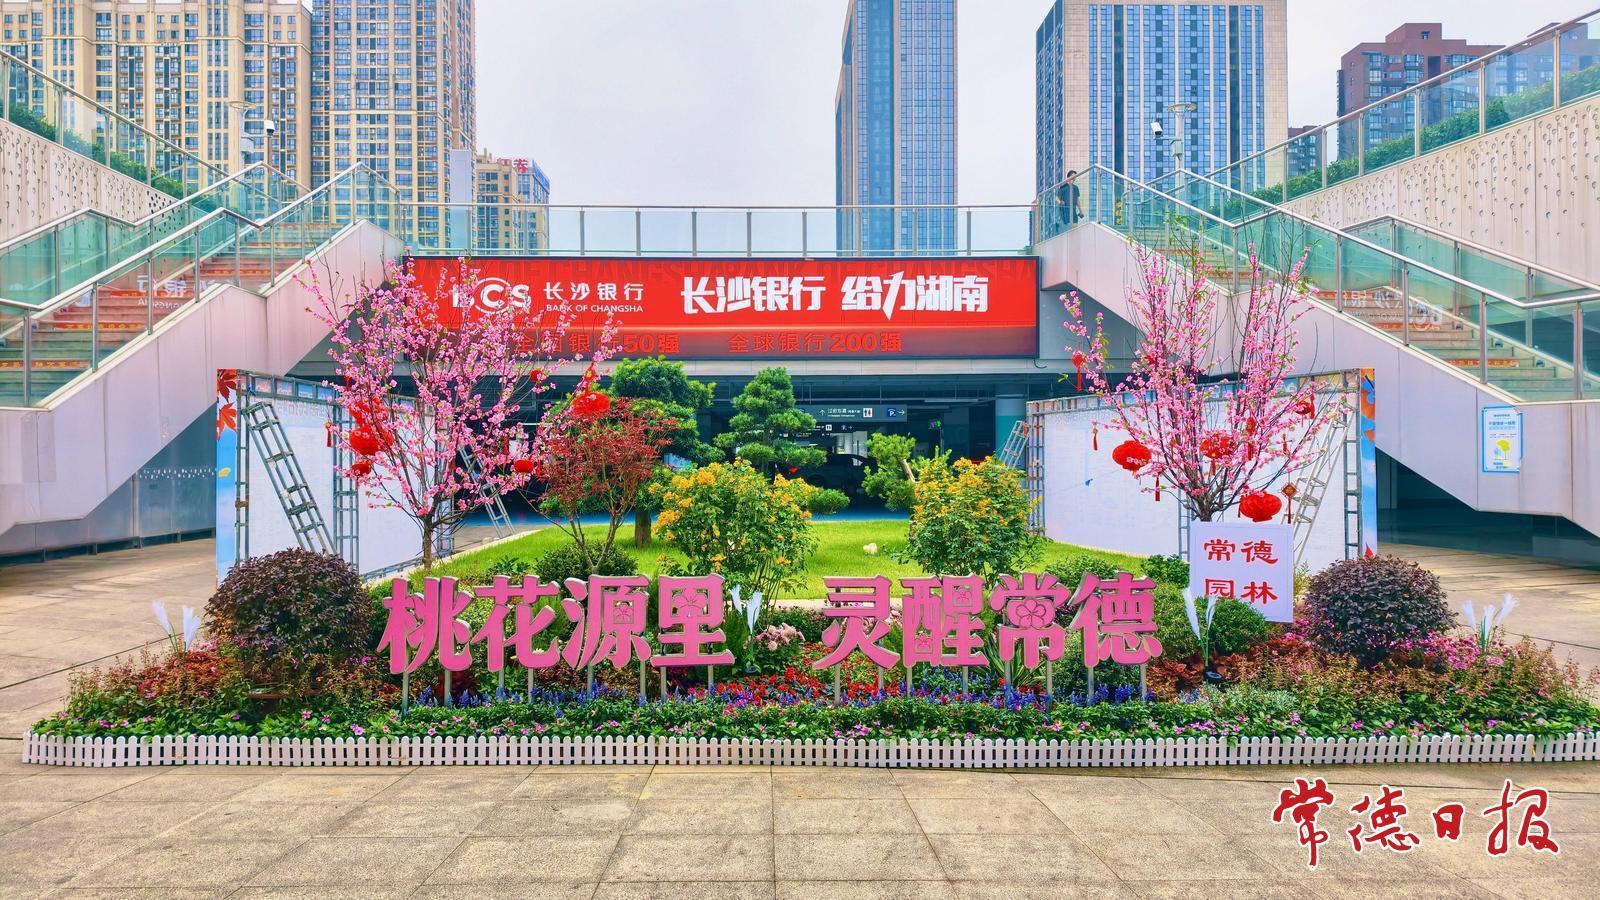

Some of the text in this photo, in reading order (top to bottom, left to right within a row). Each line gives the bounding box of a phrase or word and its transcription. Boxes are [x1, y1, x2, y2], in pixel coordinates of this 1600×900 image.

[544, 281, 644, 300] 长沙银行
[681, 271, 989, 320] 长沙银行 给力湖南
[546, 304, 644, 313] BANK OF CHANGSHA
[727, 333, 901, 353] 全球银行200强
[1204, 539, 1279, 564] 常德
[1204, 578, 1279, 604] 园林
[377, 571, 1163, 675] 桃花源里 灵醒常德
